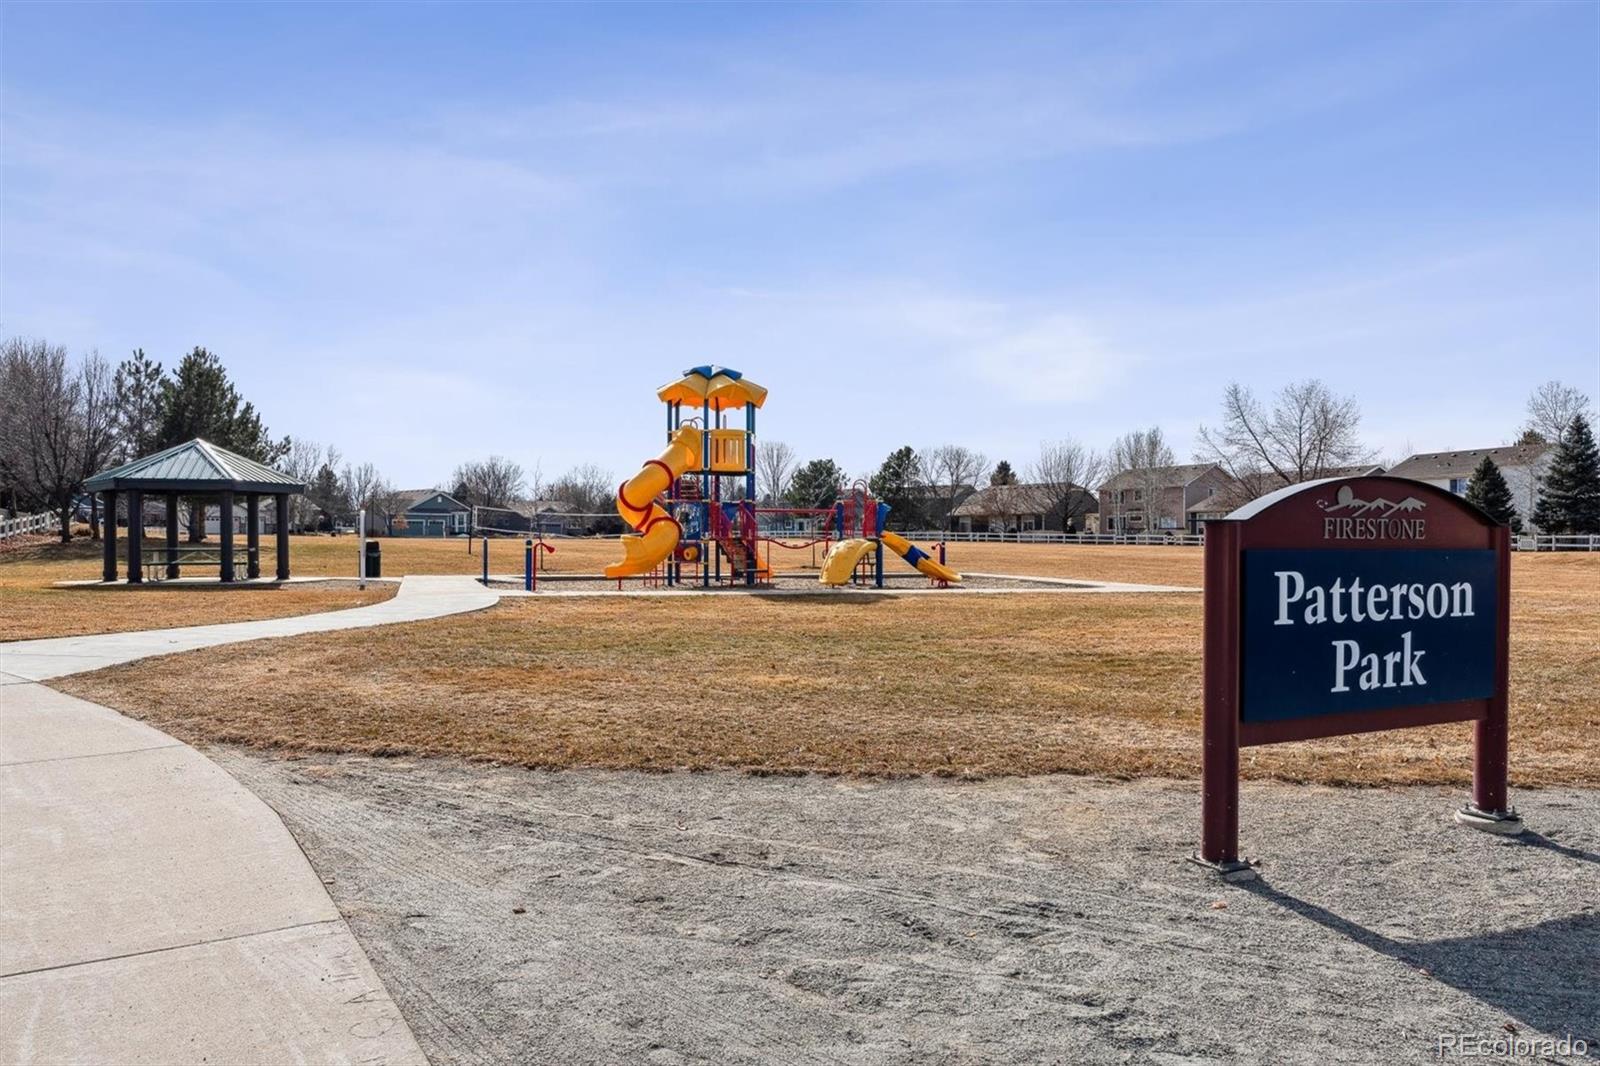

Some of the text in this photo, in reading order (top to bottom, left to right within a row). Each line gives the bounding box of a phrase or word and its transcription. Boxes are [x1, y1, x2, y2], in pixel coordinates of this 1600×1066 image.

[1323, 517, 1426, 540] FIRESTONE
[1273, 570, 1475, 626] Patterson
[1330, 630, 1427, 693] Park
